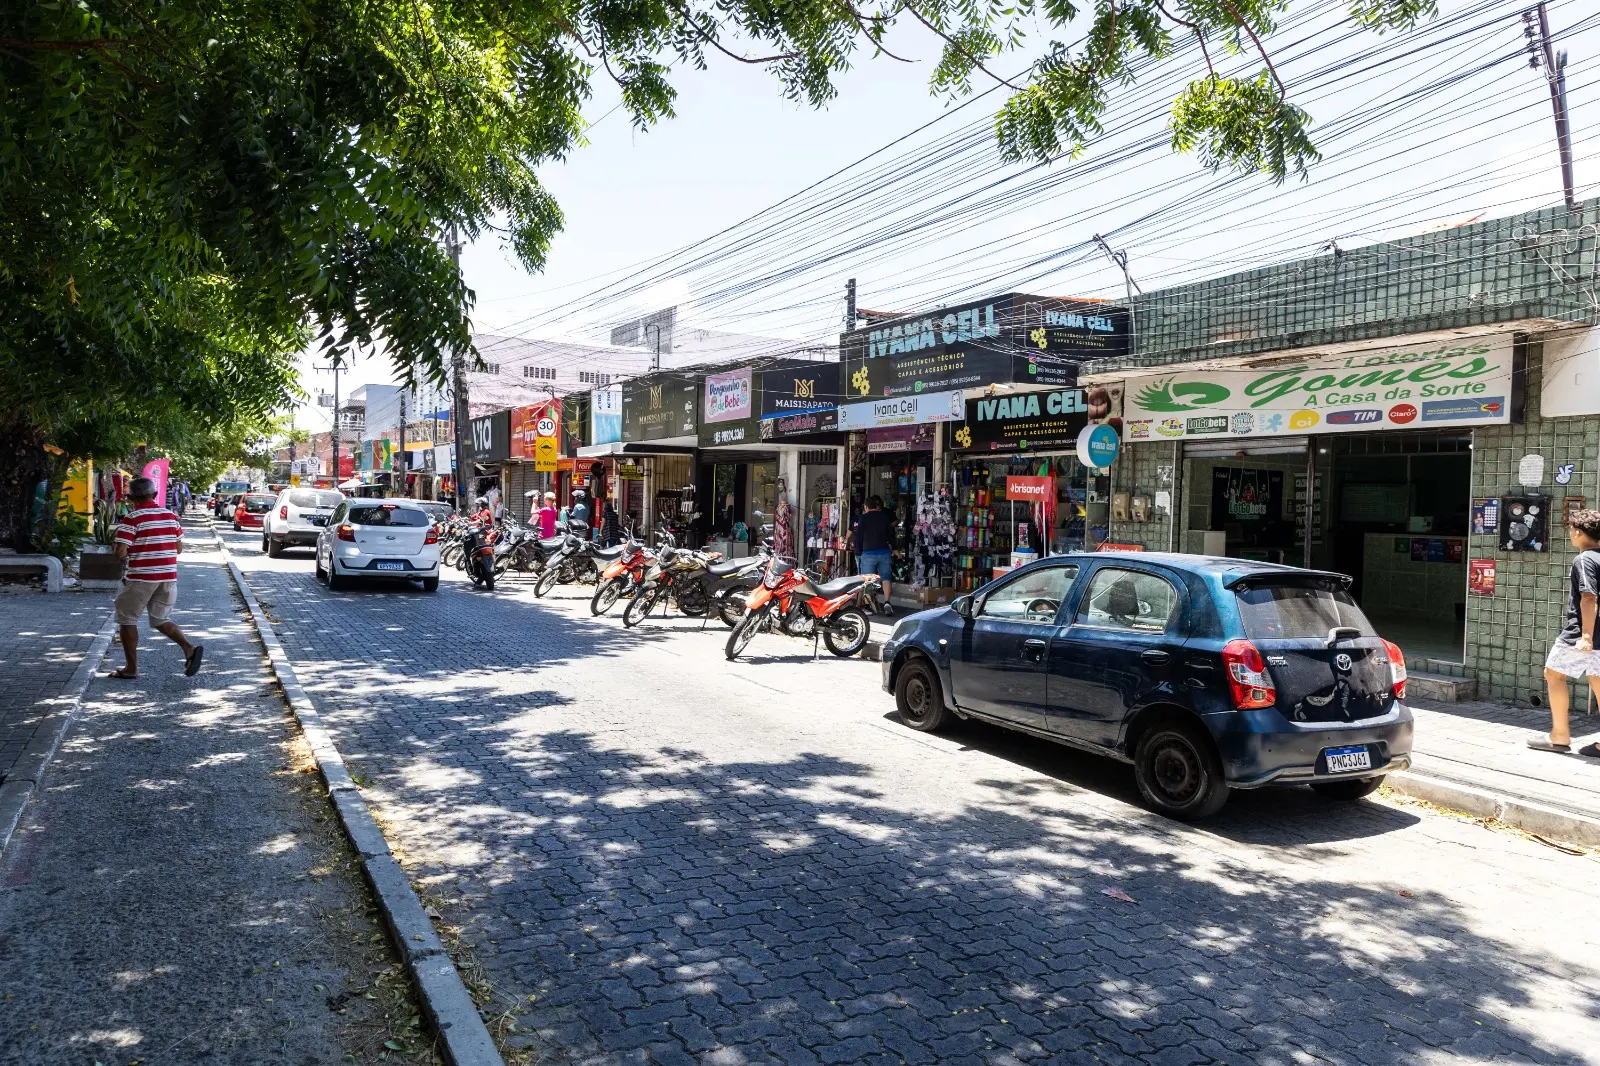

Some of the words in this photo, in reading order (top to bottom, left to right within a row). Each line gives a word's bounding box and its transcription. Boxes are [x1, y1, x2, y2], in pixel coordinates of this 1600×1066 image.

[1046, 310, 1084, 329] IVANA
[1087, 315, 1114, 332] CELL
[869, 318, 936, 358] IVANA
[942, 304, 1000, 345] CELL
[897, 357, 935, 369] ASSISTÊNCIA
[937, 352, 965, 362] TÉCNICA
[898, 369, 916, 378] CAPAS
[924, 362, 964, 374] ACESSÓRIOS
[1304, 394, 1318, 407] A
[1325, 390, 1377, 406] Casa
[1385, 387, 1411, 400] da
[1420, 380, 1487, 398] Sorte
[874, 403, 898, 416] Ivana
[900, 399, 918, 413] Cell
[977, 394, 1041, 422] IVANA
[1046, 390, 1088, 415] CEL
[1390, 410, 1411, 418] Claro
[1297, 417, 1313, 427] oi
[1353, 410, 1377, 421] TIM
[539, 420, 554, 431] 30
[1003, 422, 1040, 430] ASSISTÊNCIA
[1029, 427, 1067, 436] ACESSÓRIOS
[1014, 482, 1045, 495] brisanet
[1330, 752, 1368, 770] PNC3J61
